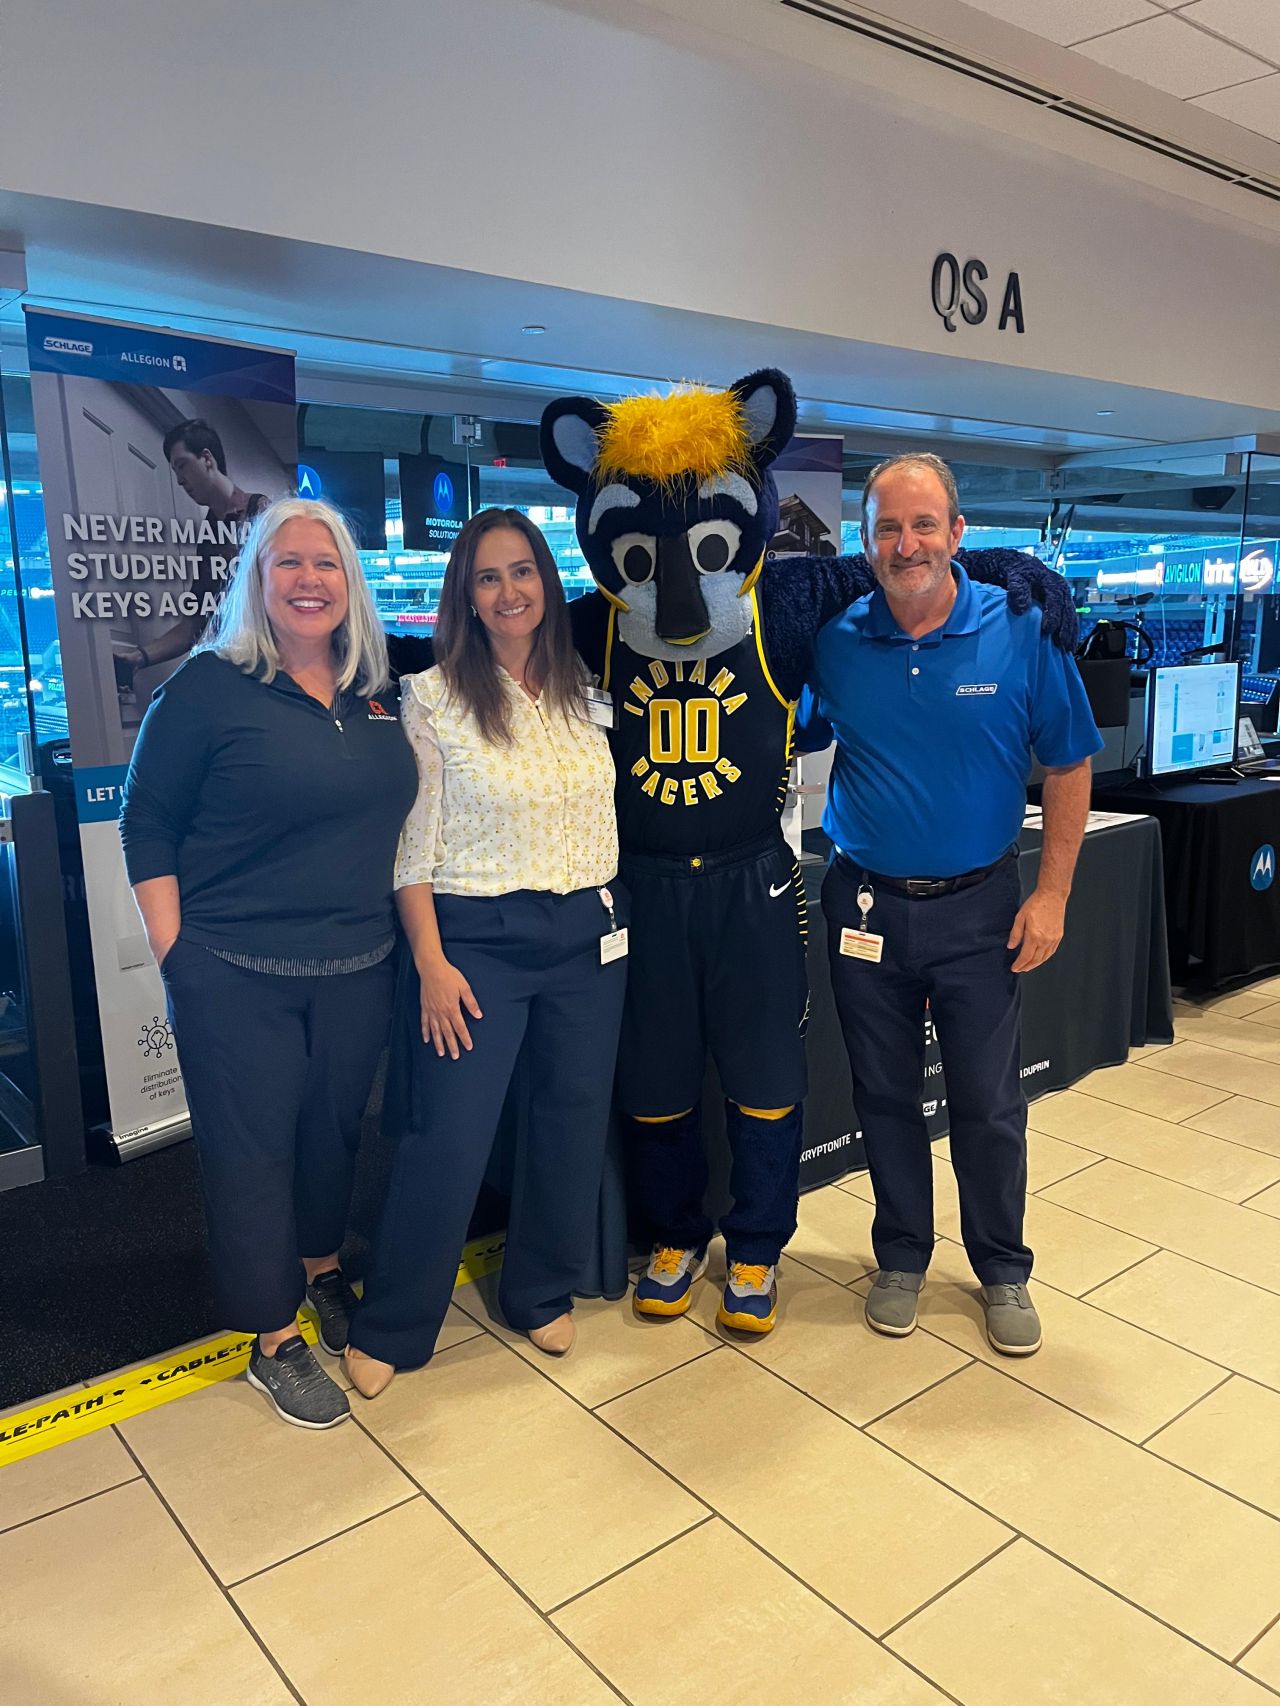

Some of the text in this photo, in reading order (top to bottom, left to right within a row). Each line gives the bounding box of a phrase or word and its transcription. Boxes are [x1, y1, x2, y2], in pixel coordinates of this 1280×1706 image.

[45, 339, 91, 353] SCHLAGE
[121, 352, 170, 368] ALLEGION
[63, 513, 164, 543] NEVER
[426, 517, 463, 529] MOTOROLA
[67, 552, 203, 580] STUDENT
[1165, 563, 1201, 583] AVIGILON
[71, 592, 152, 619] KEYS
[623, 658, 748, 717] INDIANA
[649, 697, 719, 764] 00
[631, 756, 742, 806] PACERS
[86, 786, 116, 803] LET
[143, 1067, 178, 1083] Eliminate
[1023, 1059, 1050, 1078] DUPRIN
[140, 1075, 182, 1094] distribution
[149, 1087, 176, 1101] of keys
[800, 1133, 851, 1163] KRYPTONITE
[156, 1340, 252, 1382] CABLE-P
